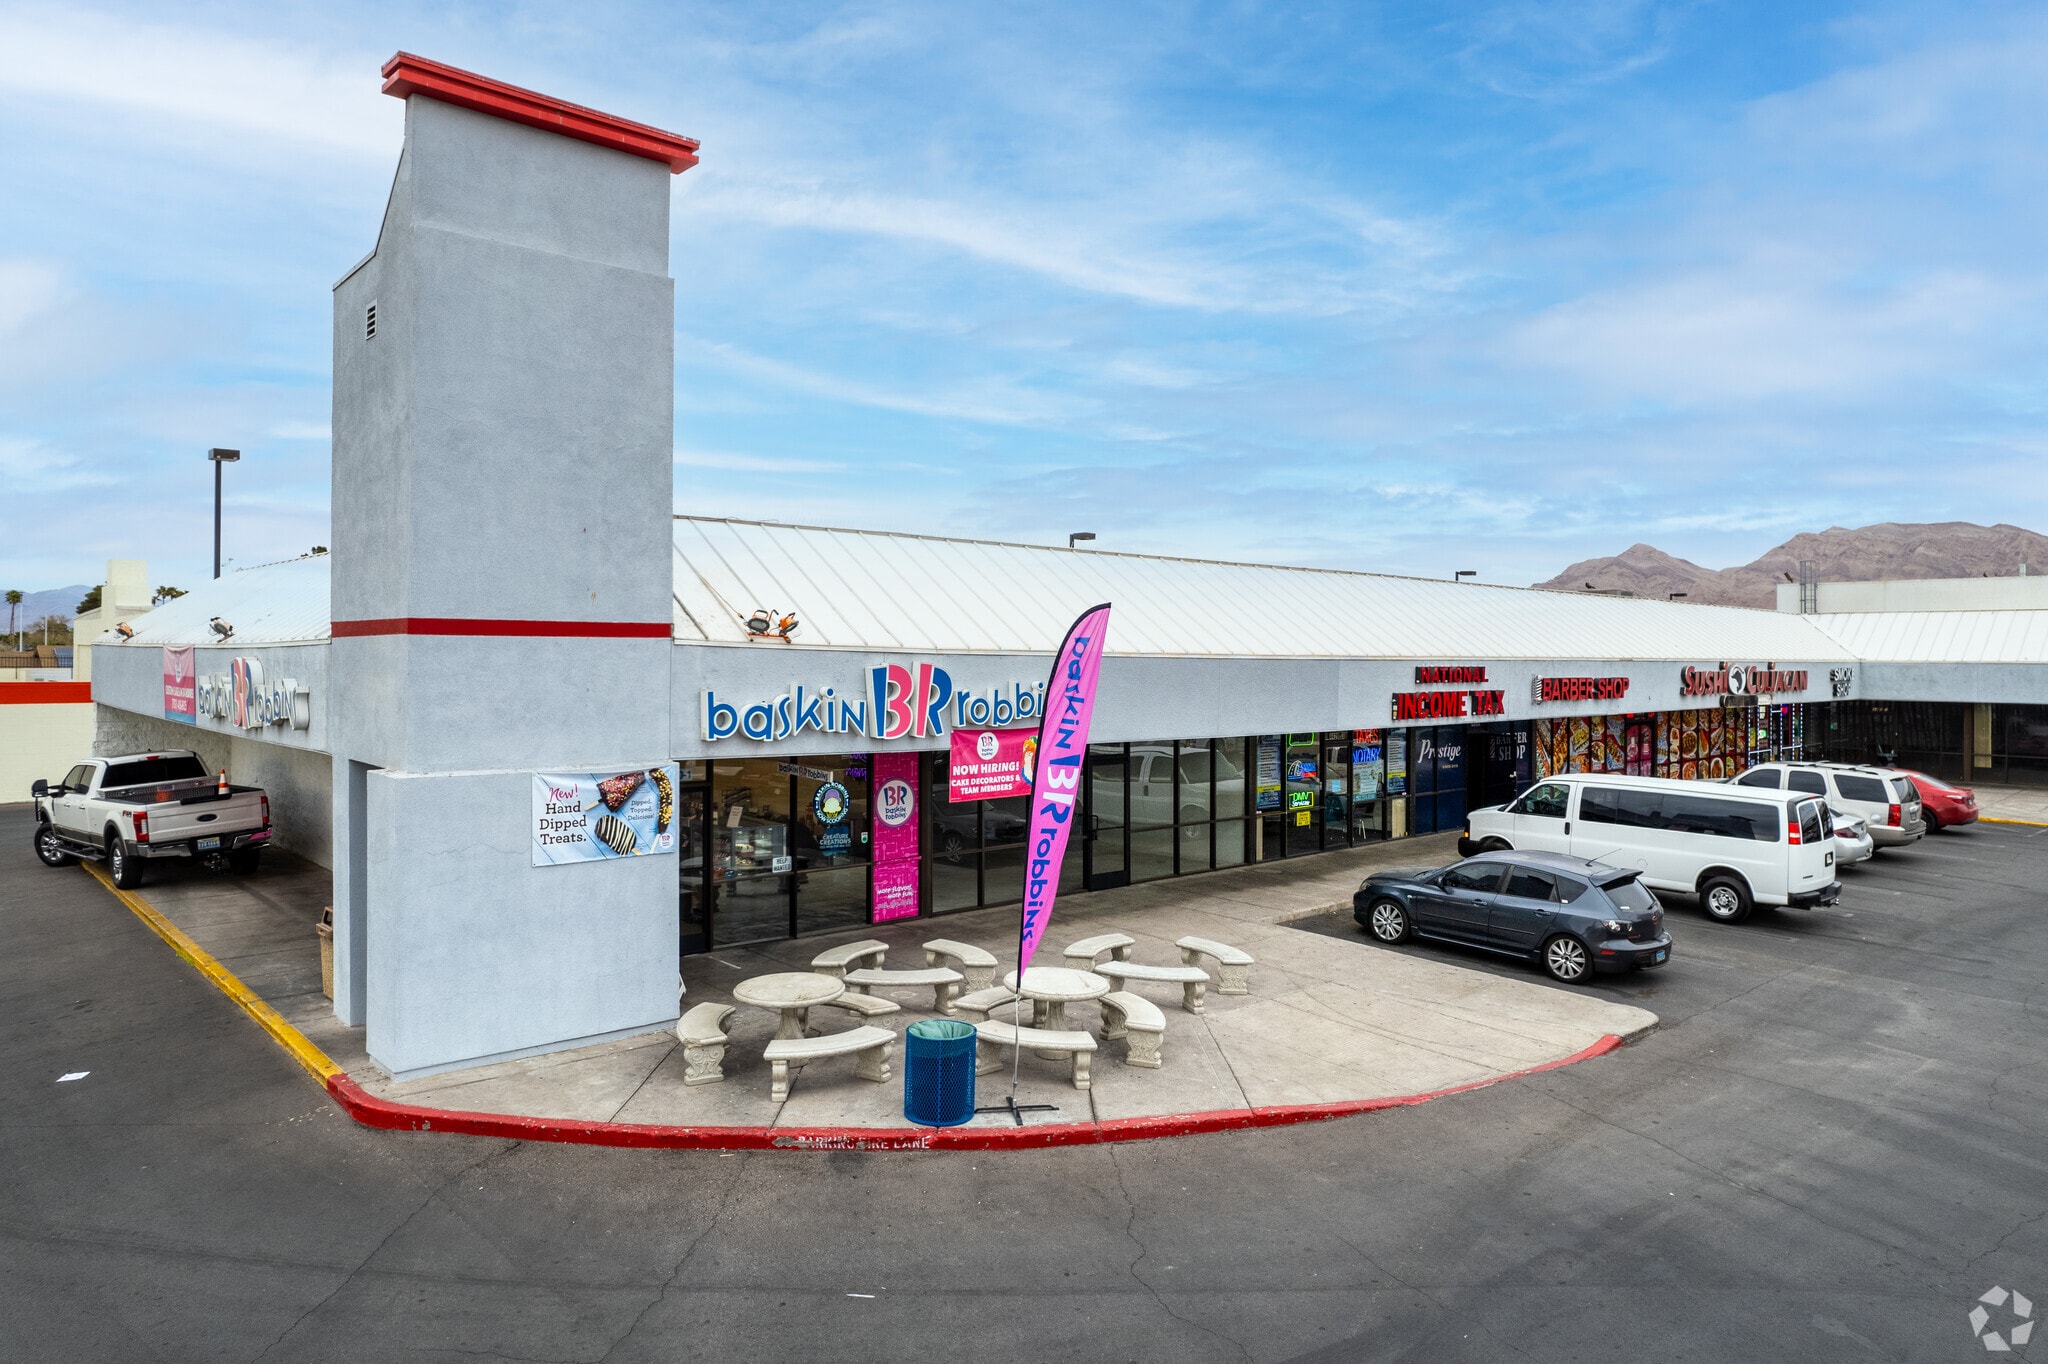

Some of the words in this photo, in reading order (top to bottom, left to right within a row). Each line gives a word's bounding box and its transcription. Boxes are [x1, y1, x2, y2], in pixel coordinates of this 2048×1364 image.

[1419, 666, 1489, 683] NATIONAL
[1834, 668, 1855, 682] SMOKE
[231, 657, 257, 729] BR
[1055, 636, 1091, 749] baskin
[1543, 677, 1594, 701] BARBER
[1597, 677, 1630, 699] SHOP
[1836, 683, 1852, 697] SHOP
[702, 683, 866, 741] baskin
[867, 662, 953, 740] BR
[955, 681, 1043, 727] robbi
[1397, 691, 1468, 720] INCOME
[1475, 689, 1505, 715] TAX
[1354, 728, 1378, 744] TAXES
[1352, 748, 1381, 763] NOTARY
[1417, 739, 1461, 763] Prstige
[953, 764, 978, 776] NOW
[981, 761, 1020, 774] HIRING!
[951, 778, 969, 787] CAKE
[970, 774, 1014, 785] DECORATORS
[1015, 774, 1020, 782] &
[549, 783, 579, 802] New!
[883, 785, 908, 807] BR
[960, 786, 979, 795] TEAM
[980, 784, 1013, 793] MEMBERS
[1040, 754, 1080, 824] BR
[545, 801, 580, 814] Hand
[885, 805, 906, 814] baskin
[540, 815, 587, 831] Dipped
[885, 812, 906, 820] robbins
[540, 833, 587, 845] Treats.
[1022, 828, 1057, 942] robbins
[893, 1135, 931, 1149] LANE
